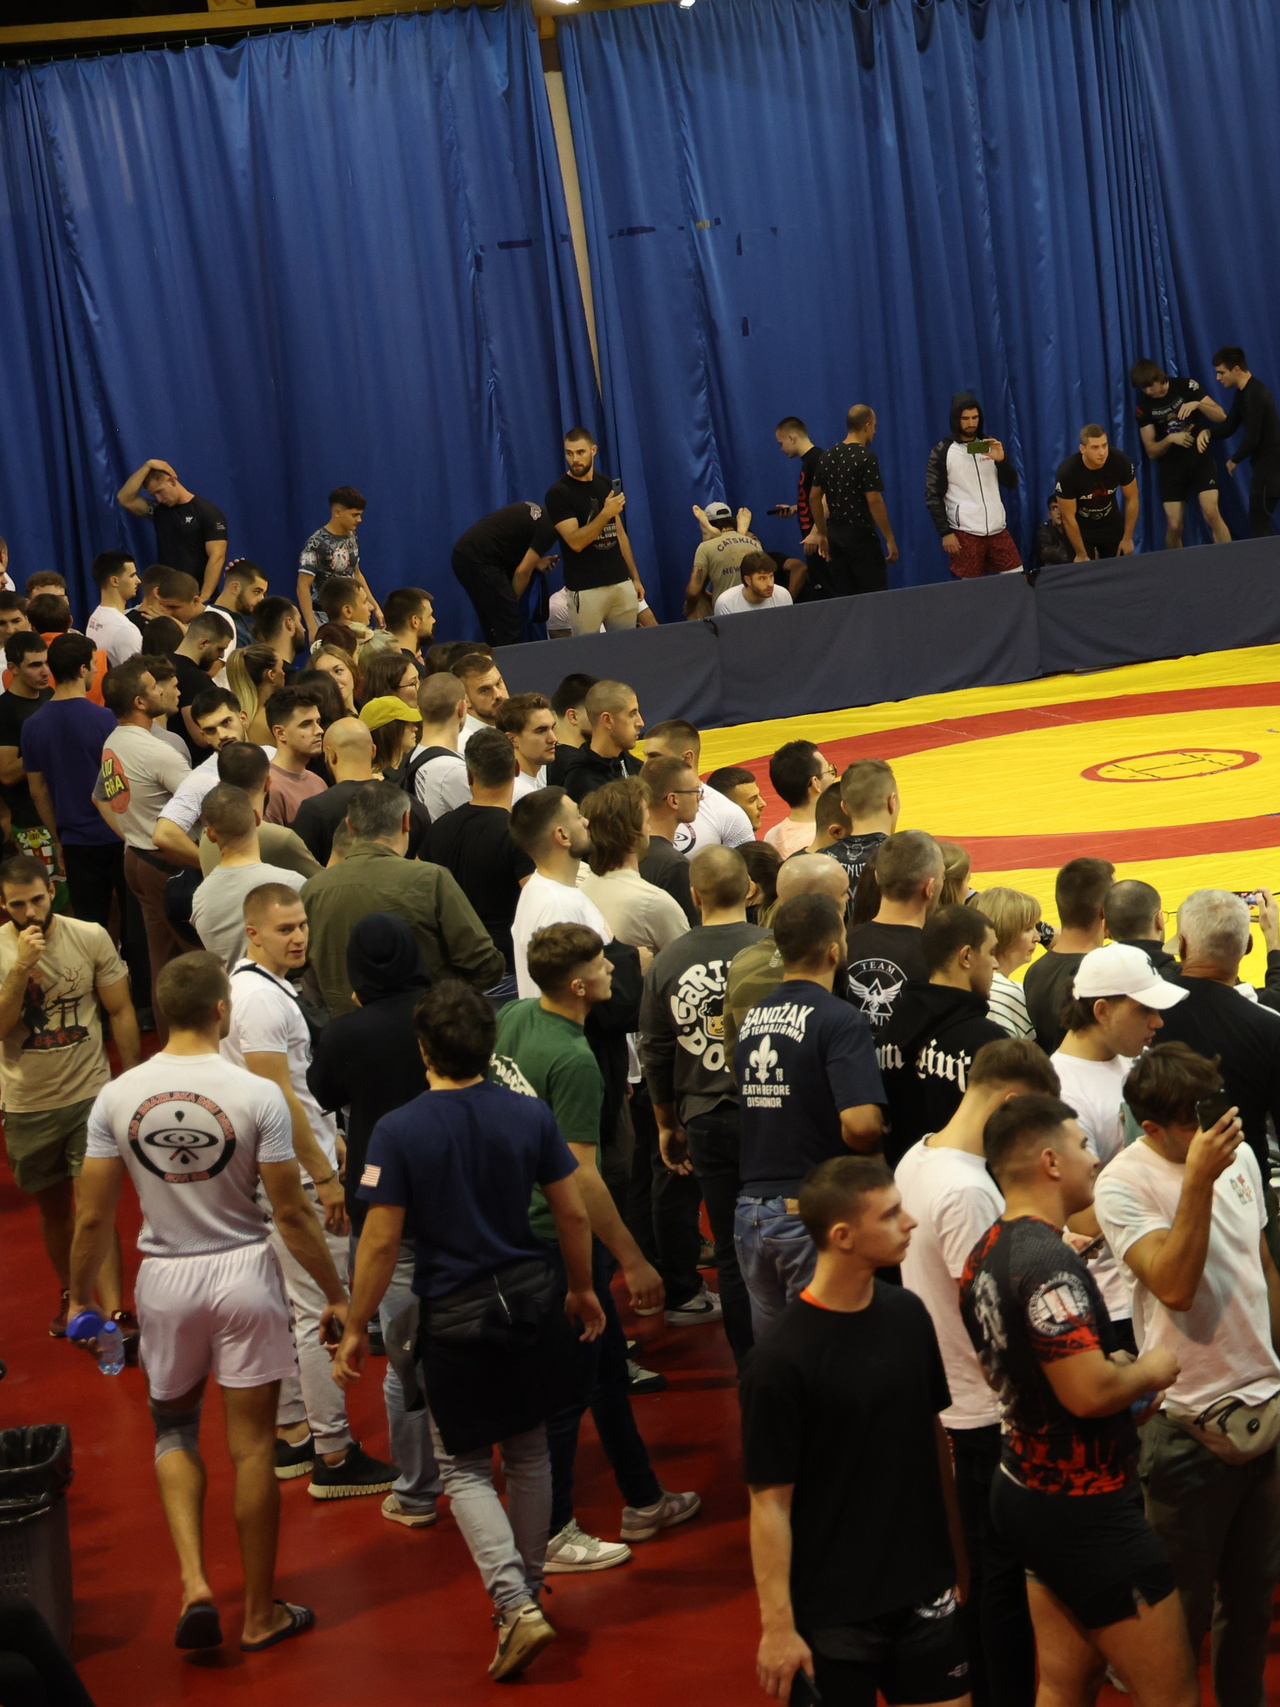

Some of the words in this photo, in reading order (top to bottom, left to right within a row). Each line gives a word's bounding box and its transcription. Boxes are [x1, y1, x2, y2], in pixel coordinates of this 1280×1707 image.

[860, 961, 896, 975] TEAM
[740, 1001, 815, 1034] SANDŽAK
[739, 1028, 751, 1043] TOP
[751, 1023, 769, 1036] TEAM
[785, 1025, 805, 1043] MMA
[762, 1084, 790, 1096] BEFORE
[747, 1096, 782, 1108] DISHONOR
